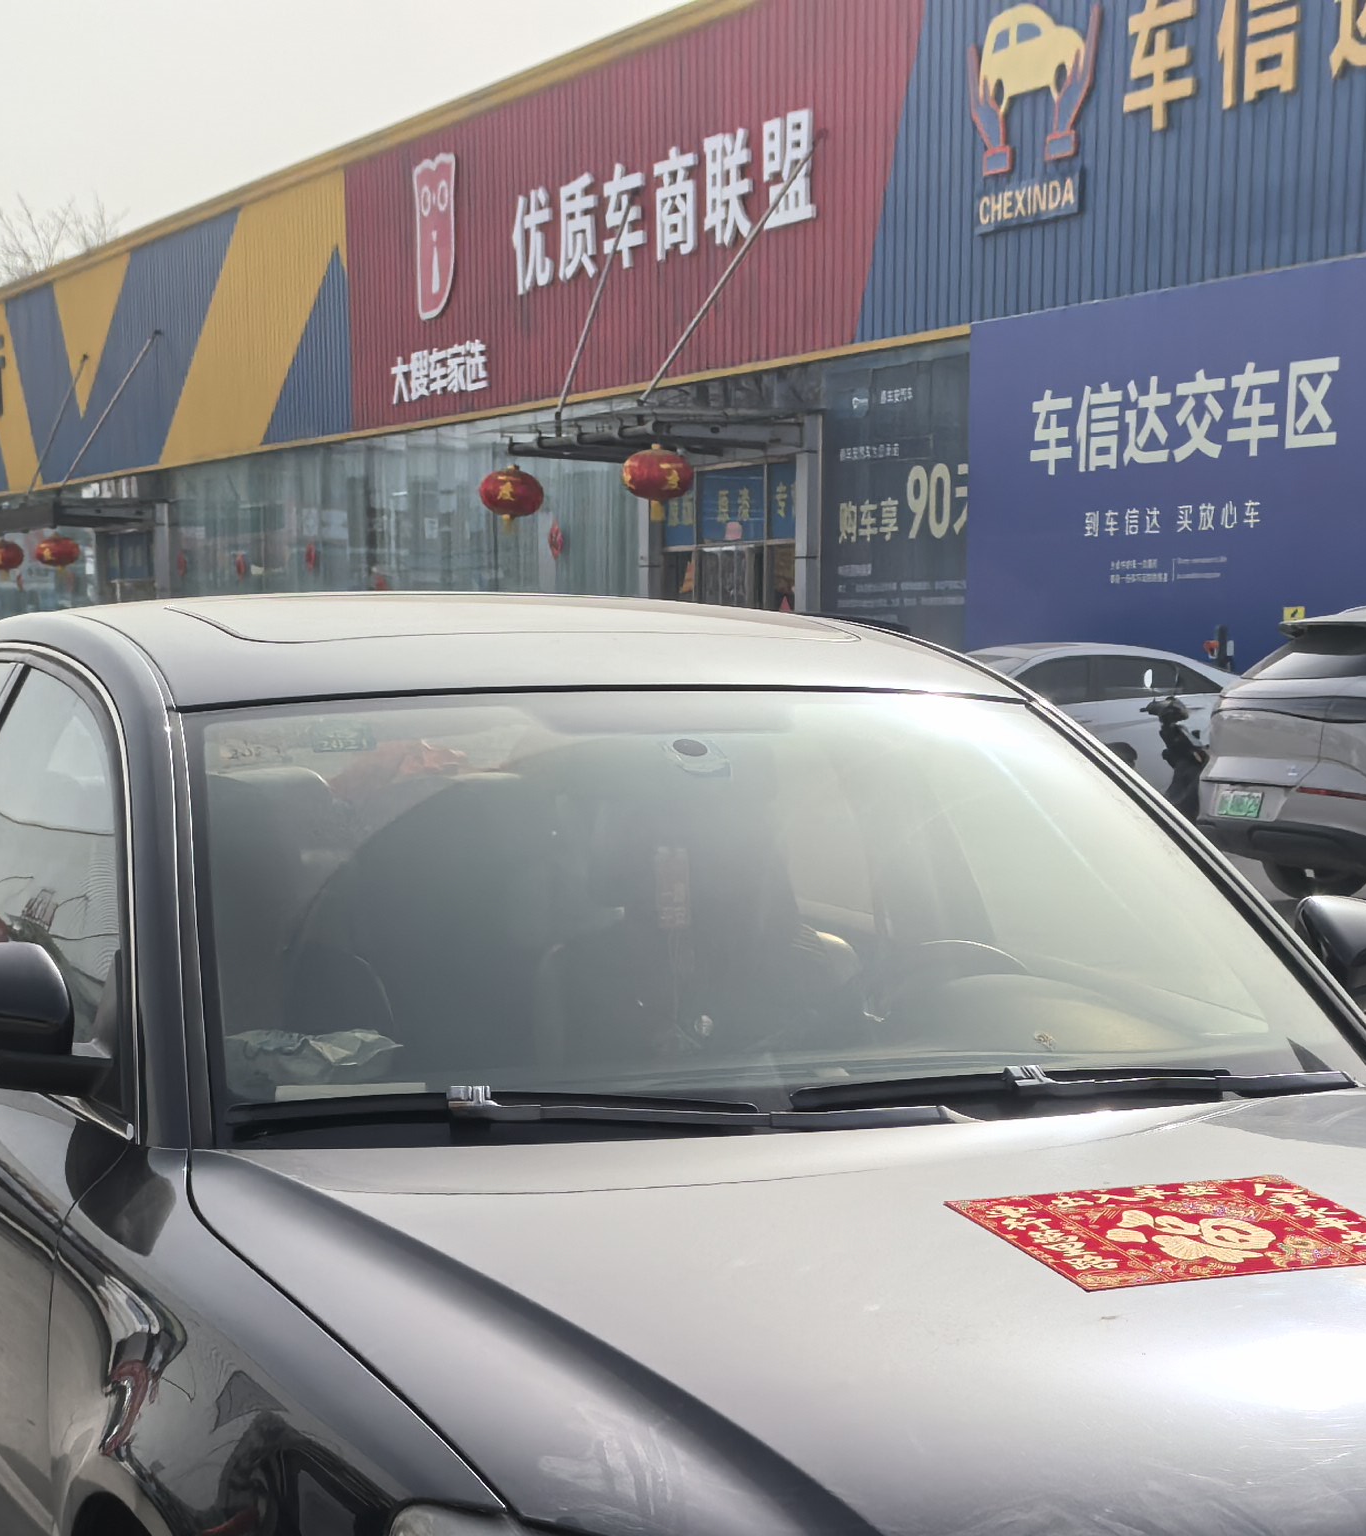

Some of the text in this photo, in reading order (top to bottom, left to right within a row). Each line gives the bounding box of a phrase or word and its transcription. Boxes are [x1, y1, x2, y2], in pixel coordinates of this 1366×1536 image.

[512, 108, 817, 296] 优质车商联盟
[978, 177, 1076, 226] CHEXINDA
[391, 339, 490, 405] 大搜车家选
[1030, 356, 1341, 476] 车信达交车区
[1084, 500, 1261, 537] 到车信达 买放心车
[1106, 1209, 1277, 1263] 福
